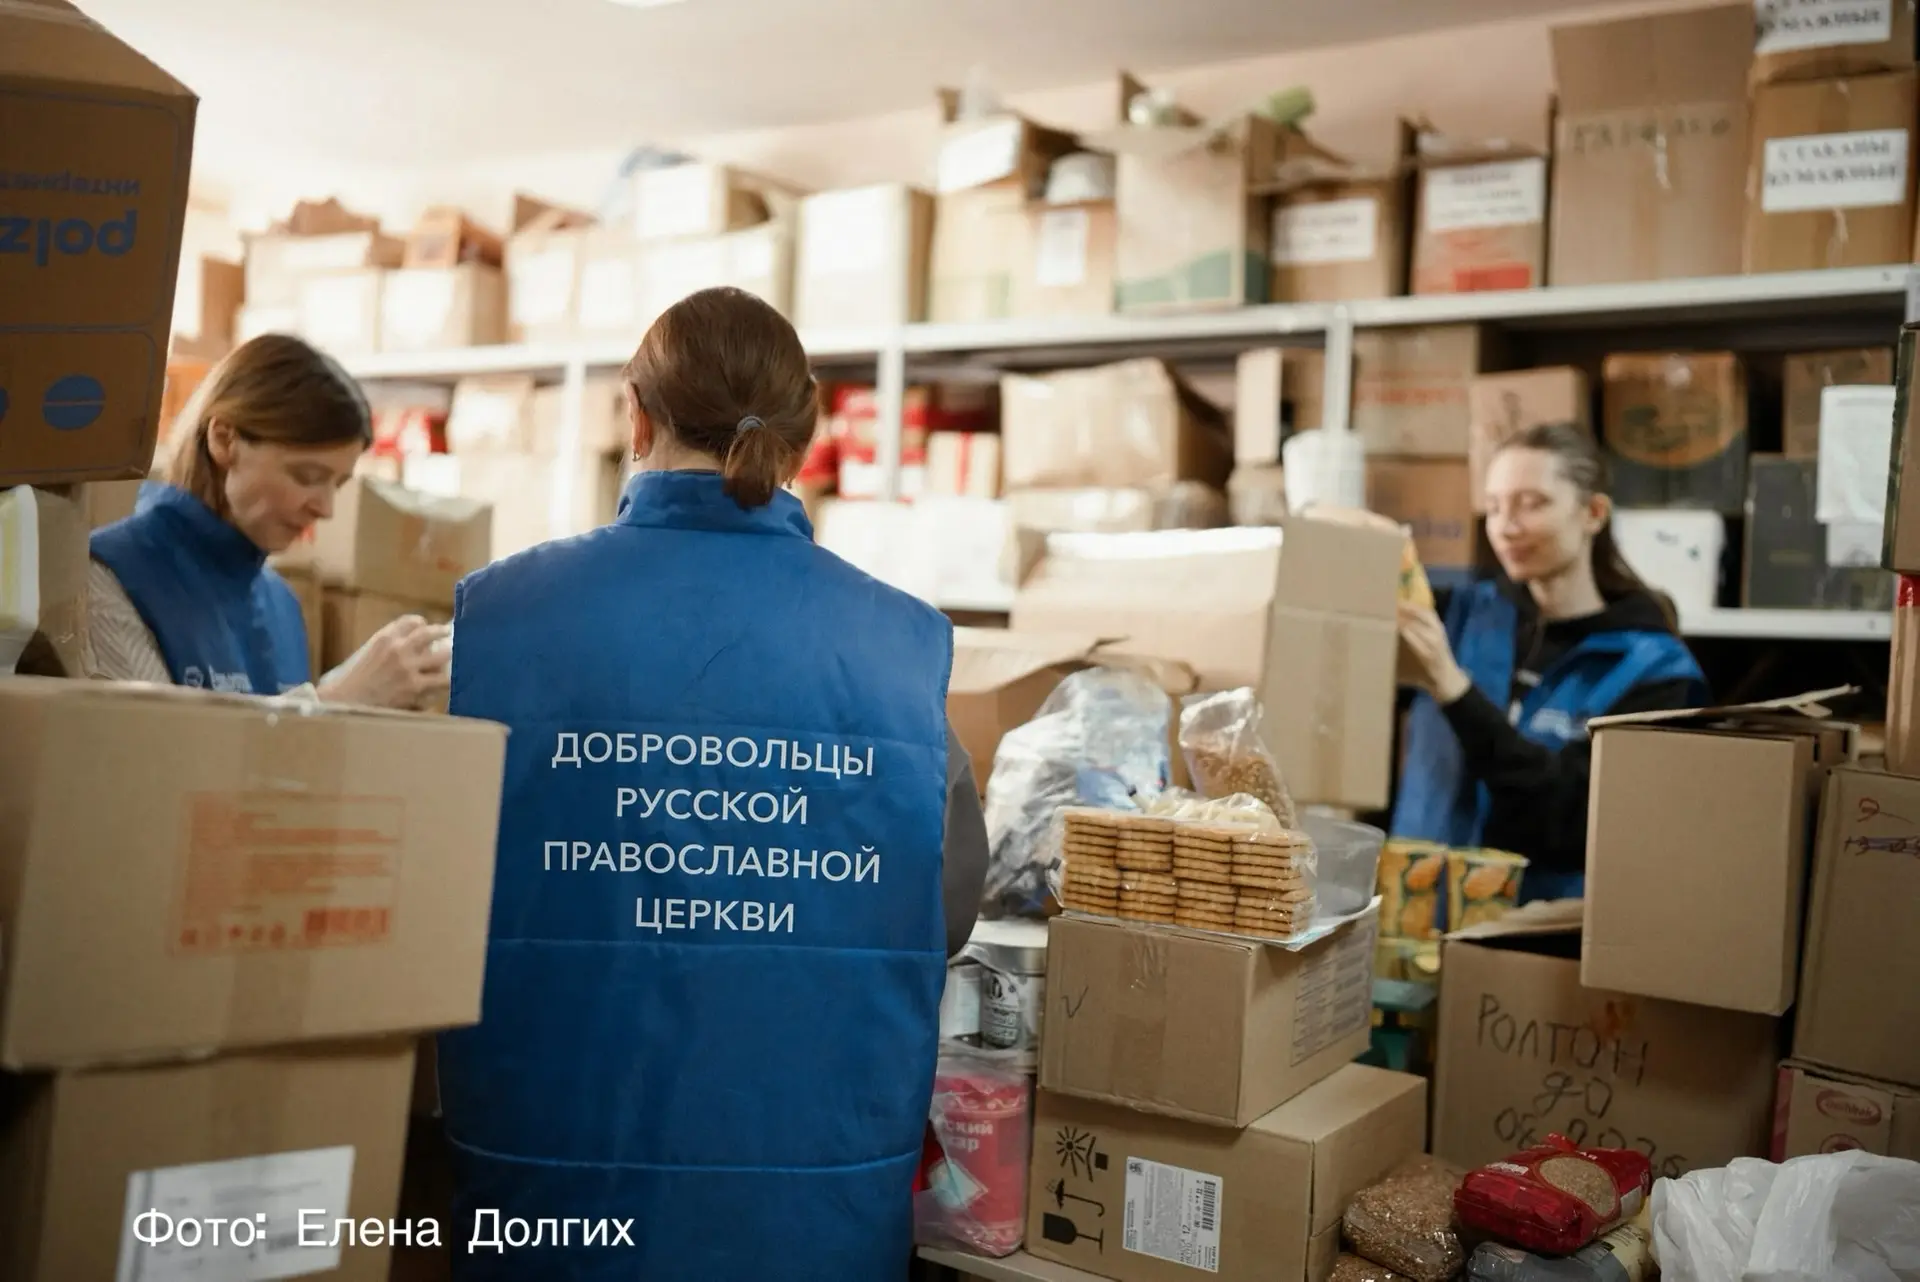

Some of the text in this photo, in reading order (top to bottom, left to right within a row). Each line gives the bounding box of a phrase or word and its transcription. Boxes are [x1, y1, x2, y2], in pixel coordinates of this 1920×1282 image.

[551, 731, 875, 780] ДОБРОВОЛЬЦЫ
[616, 786, 809, 825] РУССКОЙ
[543, 841, 881, 884] ПРАВОСЛАВНОЙ
[635, 896, 796, 934] ЦЕРКВИ
